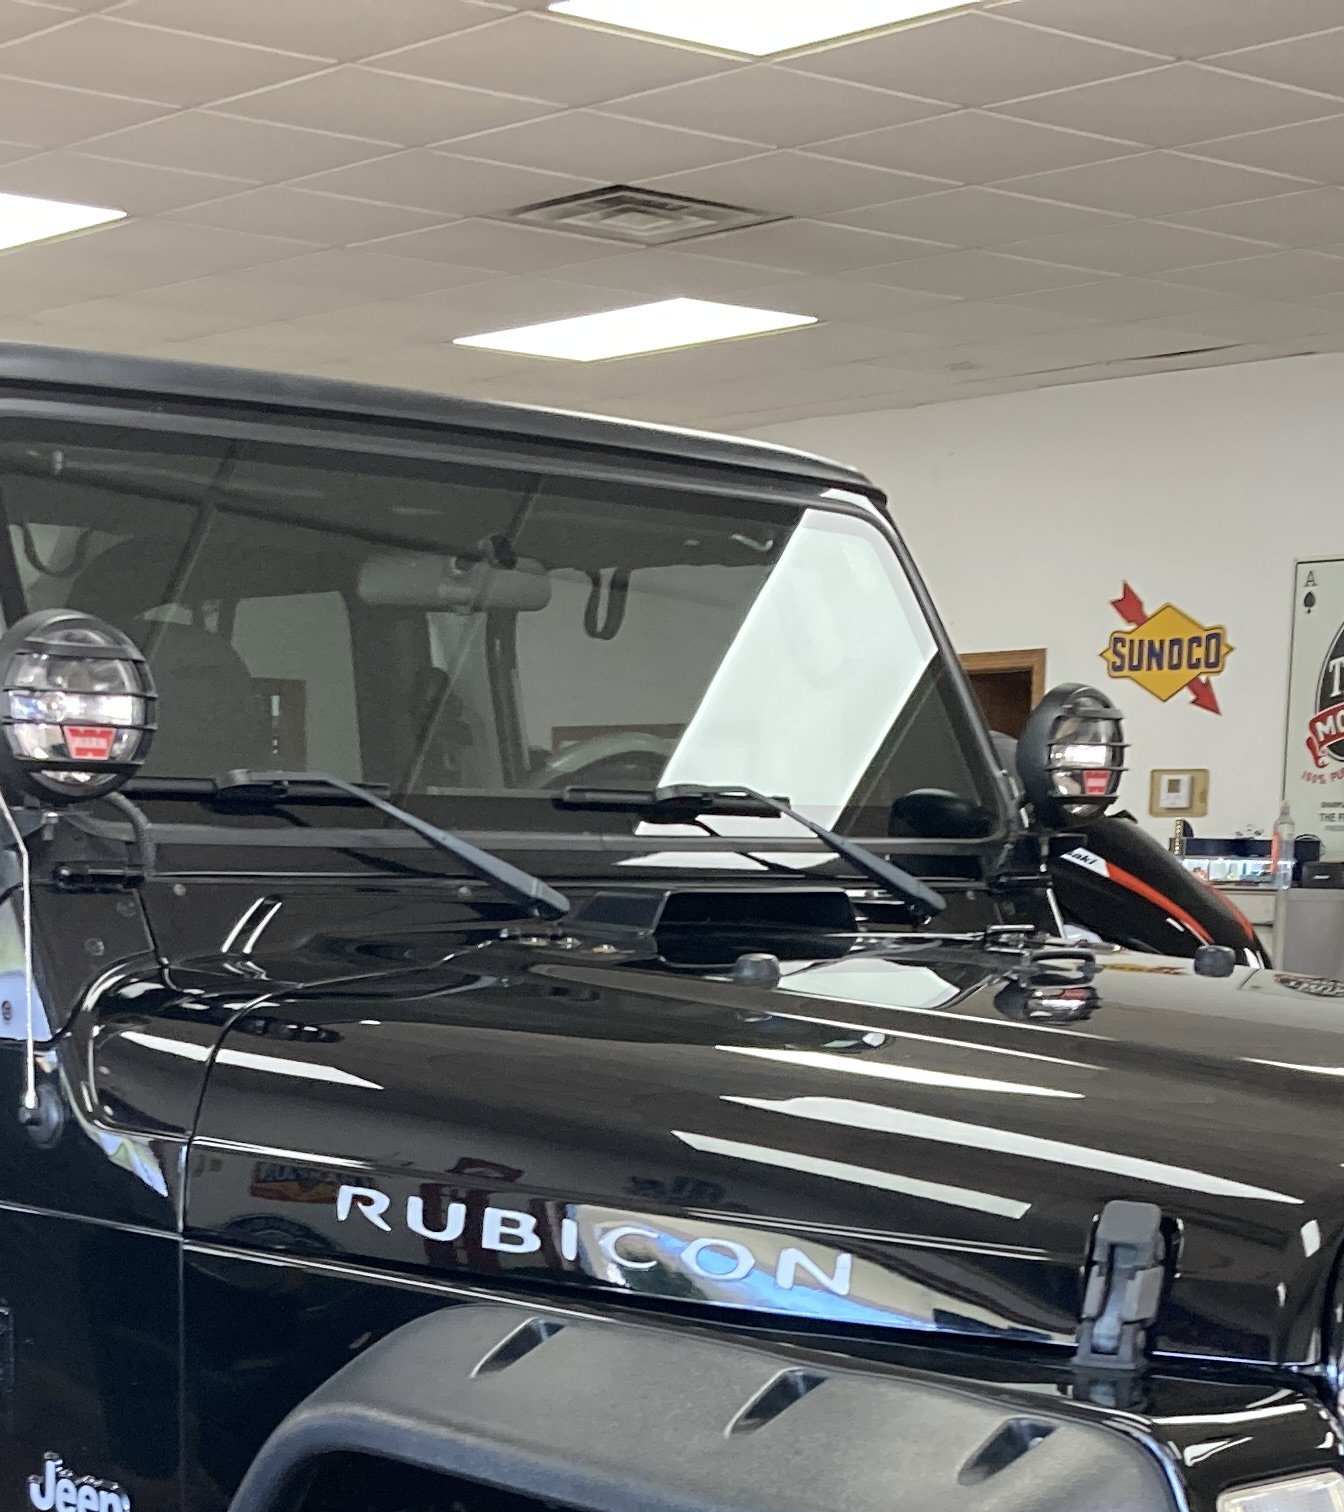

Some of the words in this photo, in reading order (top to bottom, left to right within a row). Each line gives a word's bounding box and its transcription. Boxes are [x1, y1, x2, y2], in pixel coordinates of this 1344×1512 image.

[1304, 570, 1317, 588] A
[1111, 632, 1222, 672] SUNOCO
[336, 1184, 853, 1297] RUBICON
